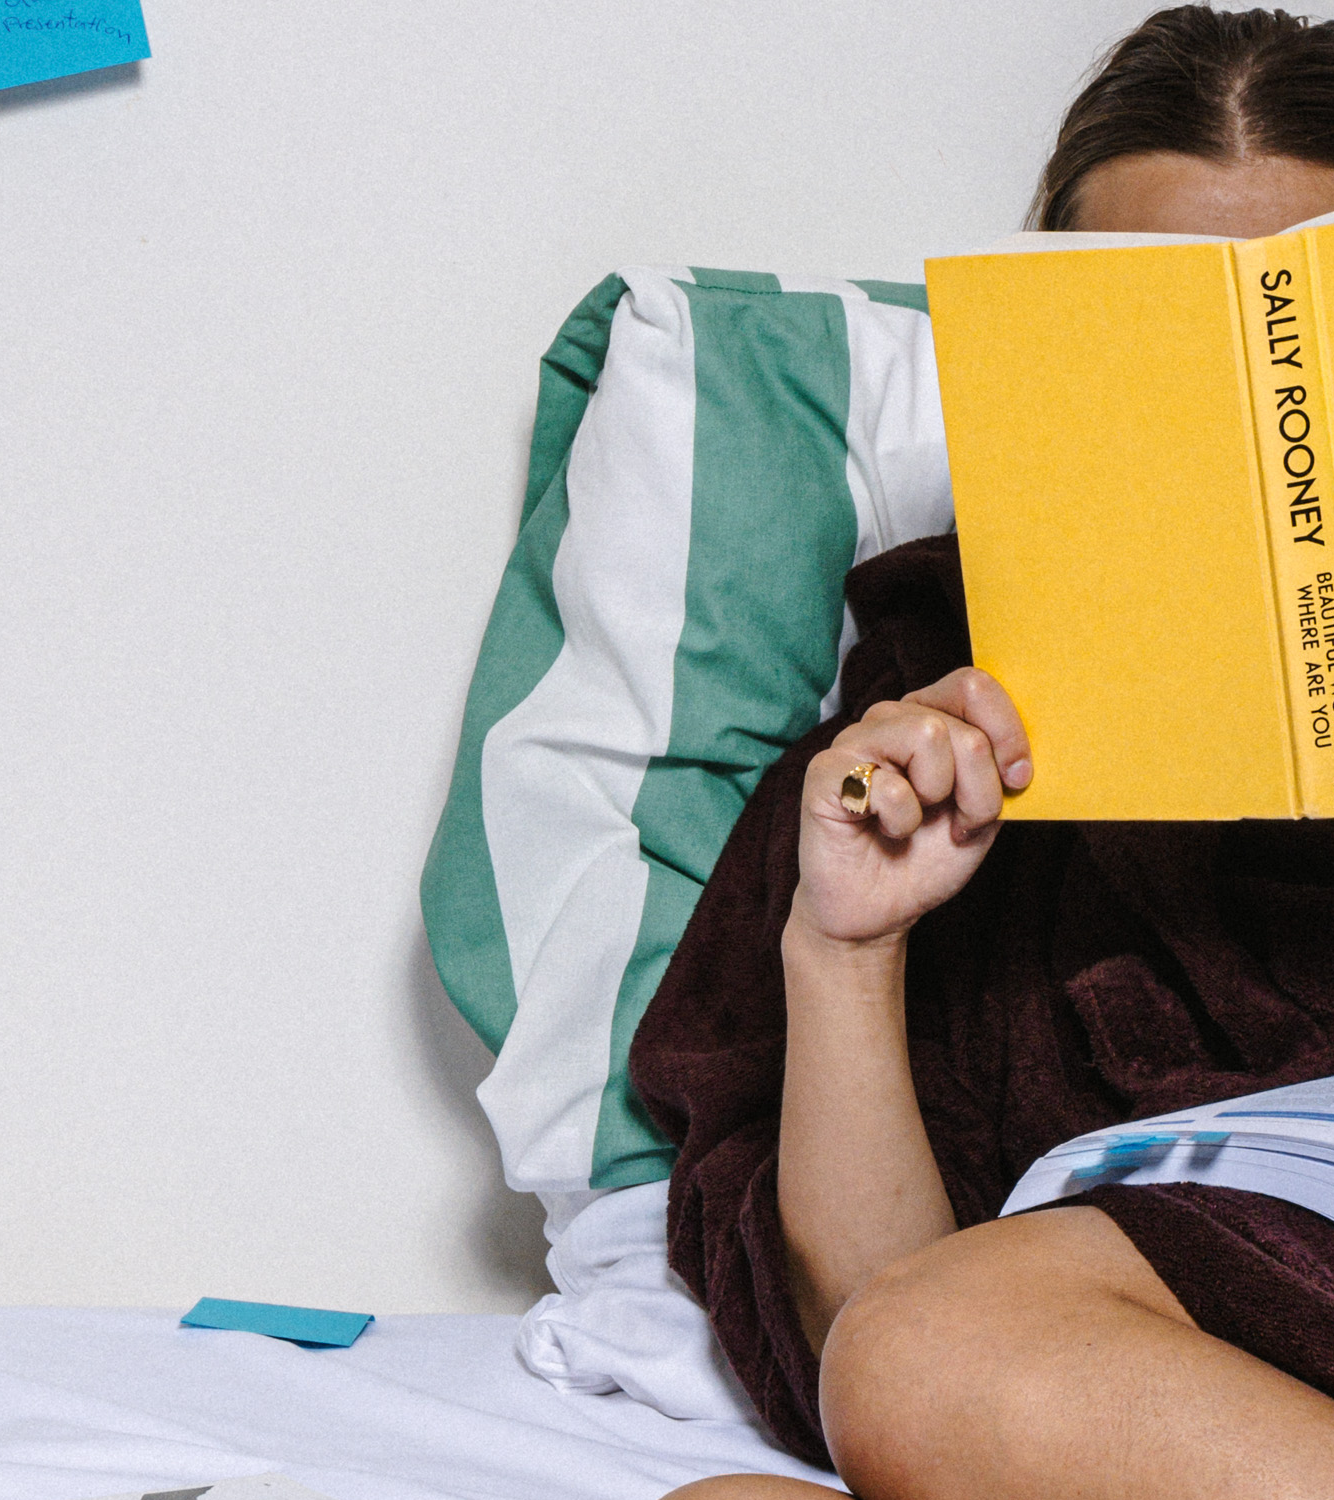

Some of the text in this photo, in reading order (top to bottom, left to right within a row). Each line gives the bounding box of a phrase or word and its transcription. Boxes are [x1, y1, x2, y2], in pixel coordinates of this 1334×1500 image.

[1260, 269, 1325, 547] SALLY ROONEY
[1296, 583, 1332, 749] WHERE ARE YOU
